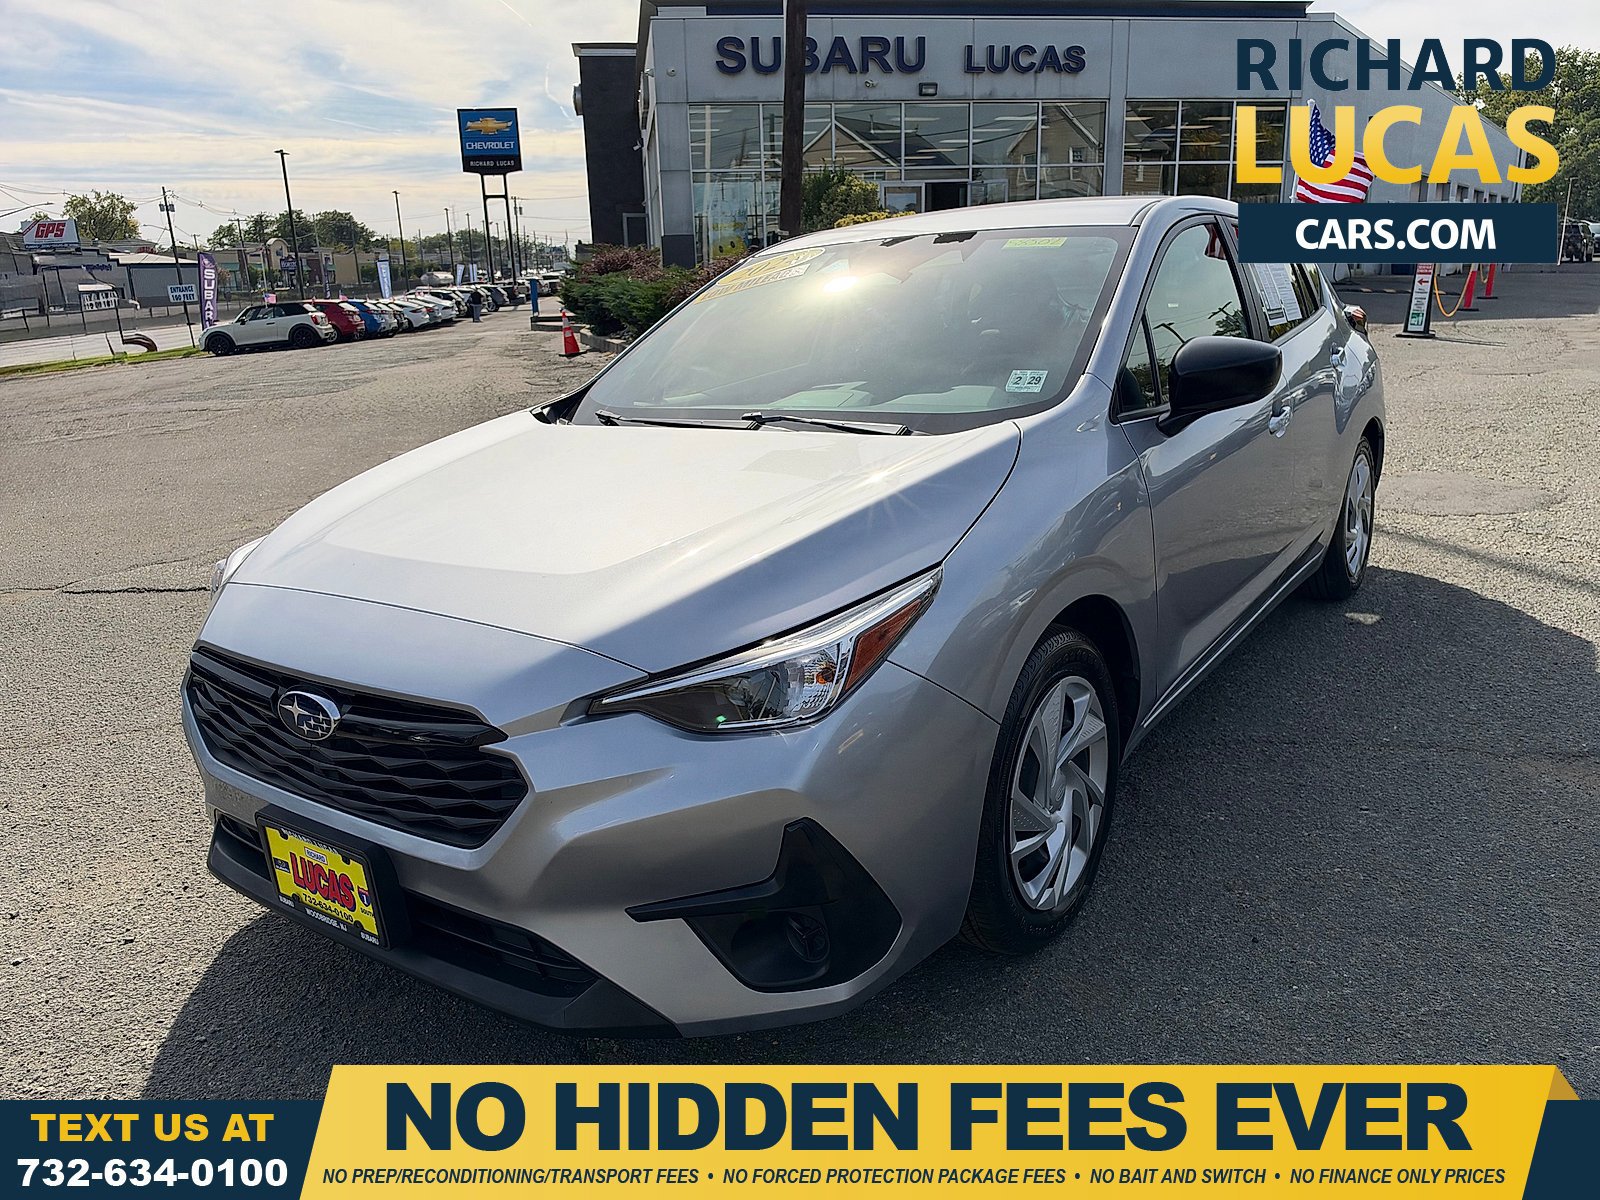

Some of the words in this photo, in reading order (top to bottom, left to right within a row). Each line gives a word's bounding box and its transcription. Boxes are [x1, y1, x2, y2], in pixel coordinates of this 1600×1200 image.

[963, 45, 1087, 74] LUCAS
[465, 141, 515, 150] CHEVROLET
[34, 222, 67, 239] GPS
[170, 286, 194, 294] ENTRANCE
[183, 293, 195, 302] FEET
[1013, 376, 1023, 386] 2
[1026, 376, 1042, 386] 29
[306, 849, 326, 864] RICHARD
[289, 852, 357, 912] LUCAS
[302, 893, 354, 923] 732-634-0100
